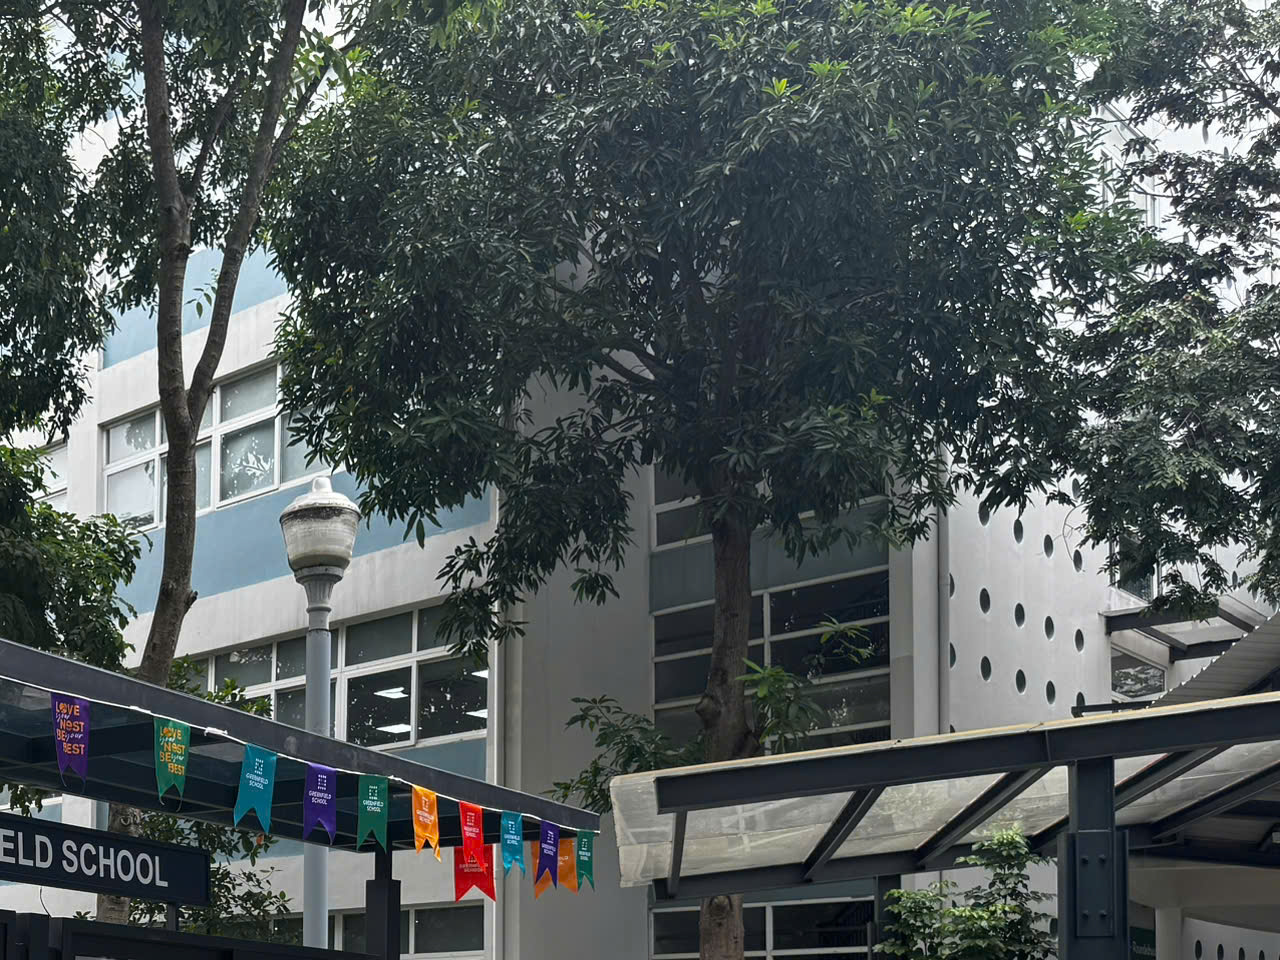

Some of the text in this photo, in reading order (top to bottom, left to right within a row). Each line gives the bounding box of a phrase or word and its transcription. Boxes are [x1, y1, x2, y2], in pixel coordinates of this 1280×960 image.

[56, 701, 80, 716] LOVE
[56, 728, 66, 741] BE
[246, 773, 269, 785] GREENFIELD
[249, 780, 264, 790] SCHOOL
[308, 790, 332, 800] GREENFIELD
[312, 797, 328, 805] SCHOOL
[62, 839, 169, 888] SCHOOL
